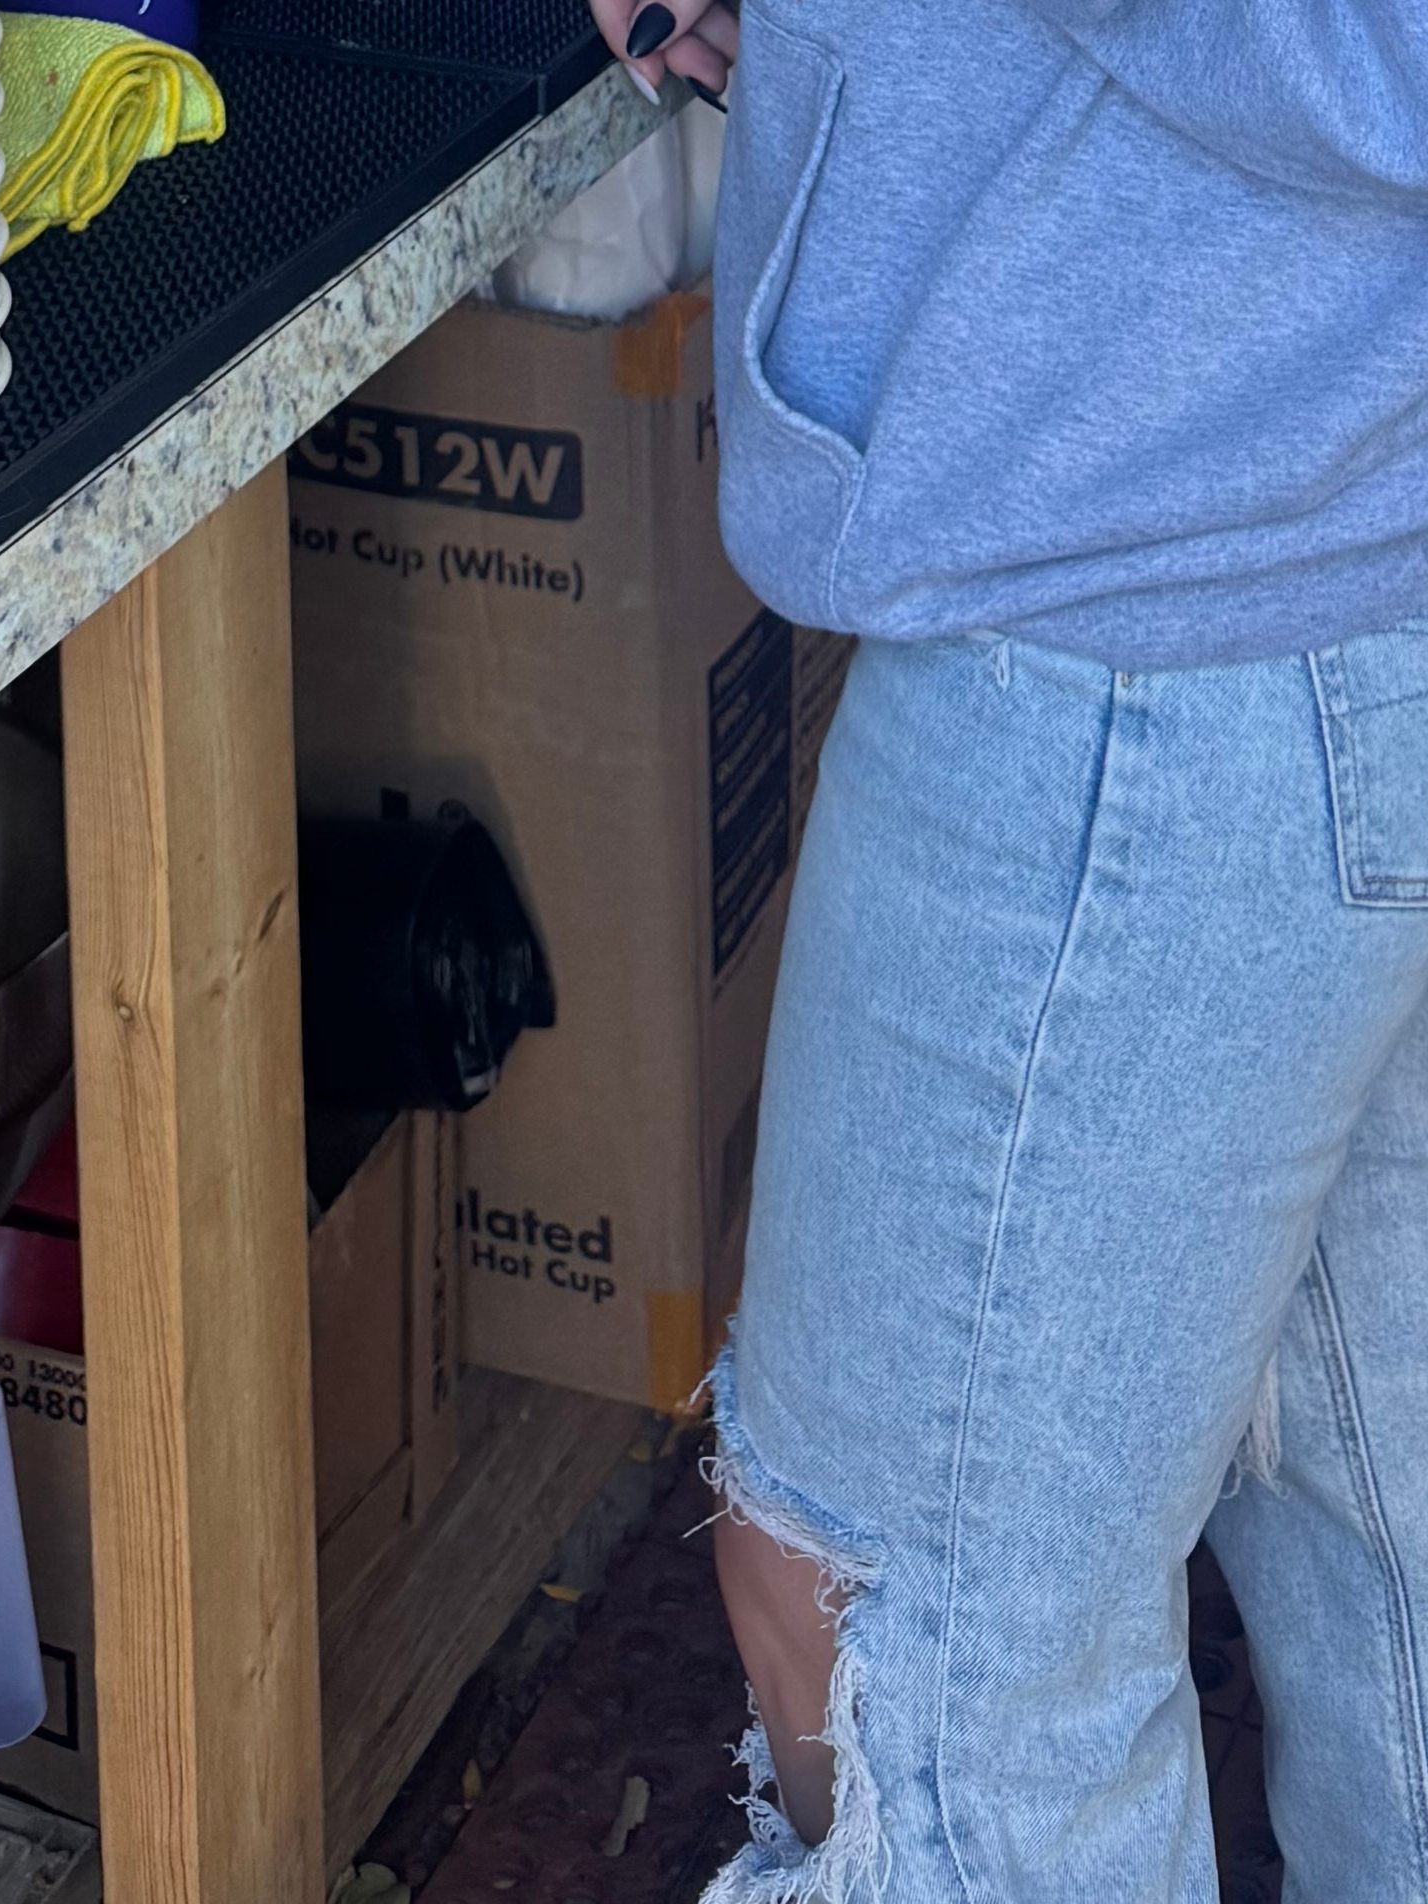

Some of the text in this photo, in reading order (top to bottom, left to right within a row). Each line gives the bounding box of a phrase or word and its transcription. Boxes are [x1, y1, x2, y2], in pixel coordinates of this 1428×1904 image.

[352, 528, 424, 578] Cup
[439, 542, 585, 604] (White)
[454, 1187, 613, 1264] lated
[472, 1239, 615, 1304] Hot Cup
